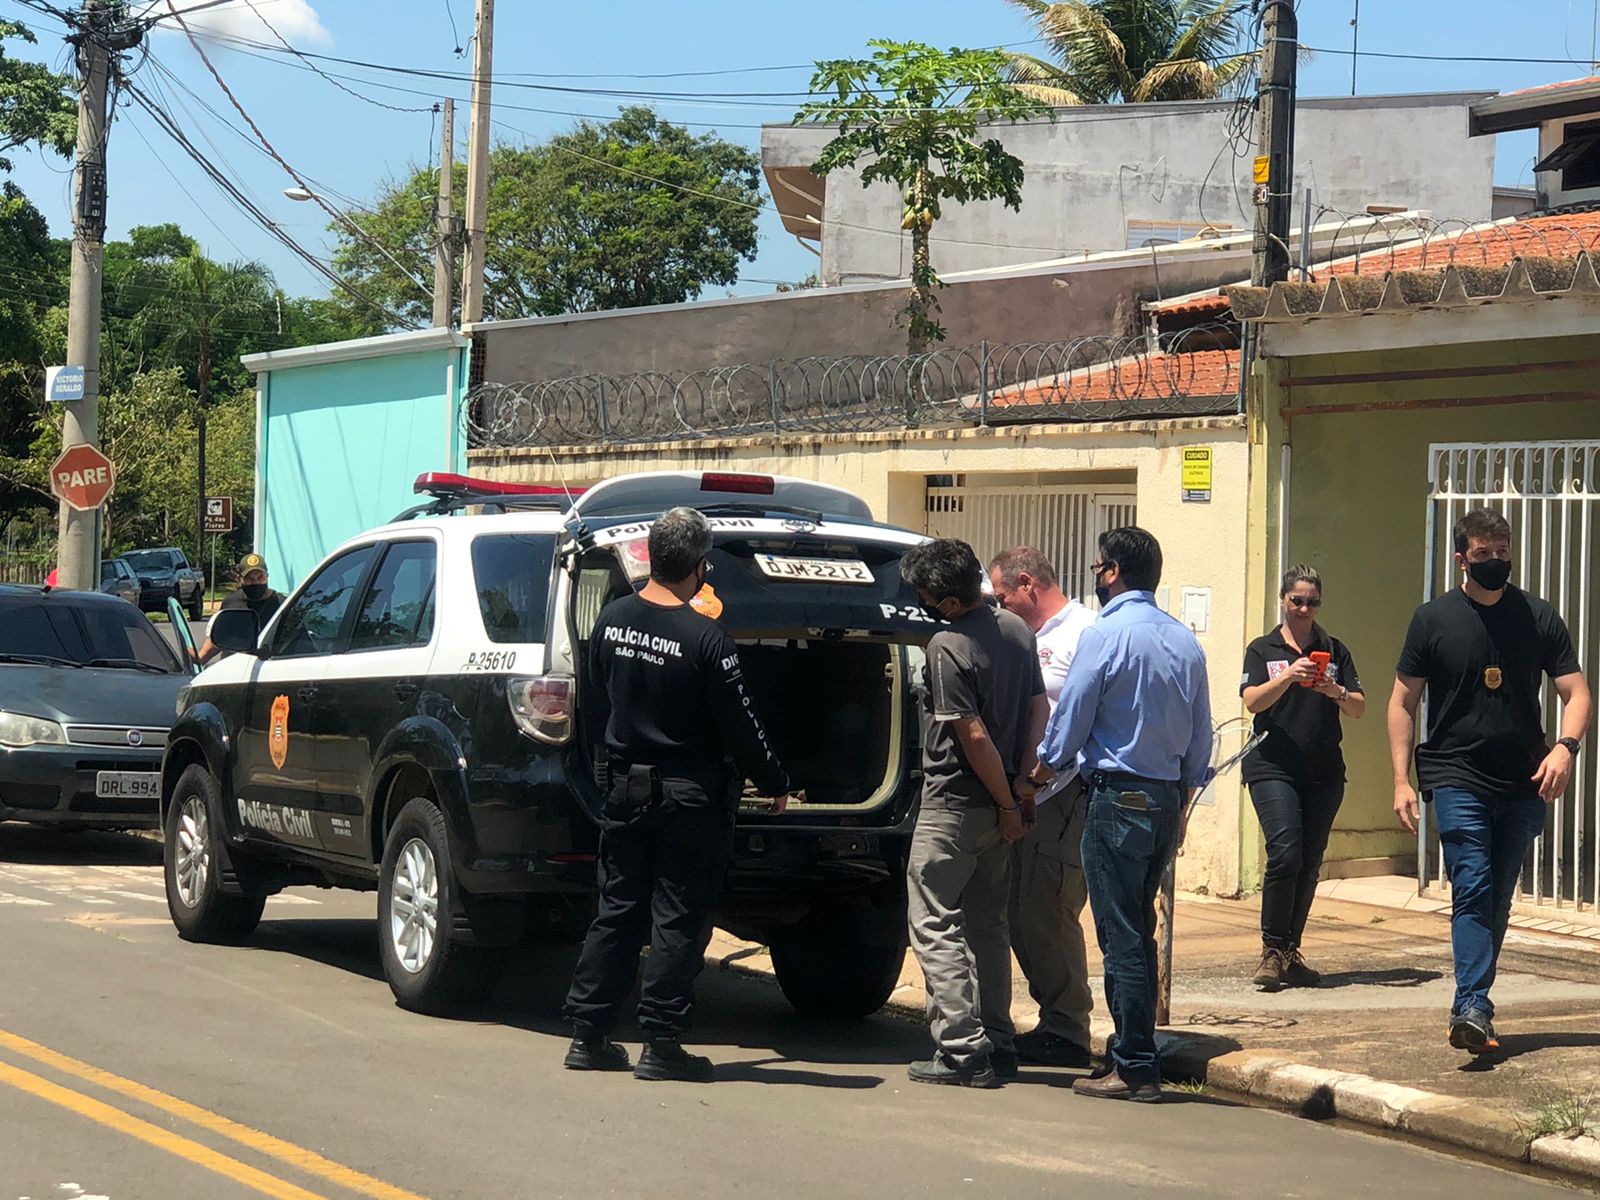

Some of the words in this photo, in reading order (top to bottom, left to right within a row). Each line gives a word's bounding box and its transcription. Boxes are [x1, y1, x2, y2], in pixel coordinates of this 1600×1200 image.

[58, 466, 107, 488] PARE
[765, 561, 867, 579] DJM-2212
[604, 626, 650, 648] POLÍCIA
[651, 636, 683, 657] CIVIL
[615, 646, 635, 658] SÃO
[636, 650, 665, 666] PAULO
[237, 798, 283, 832] Polícia
[282, 806, 314, 838] Civil
